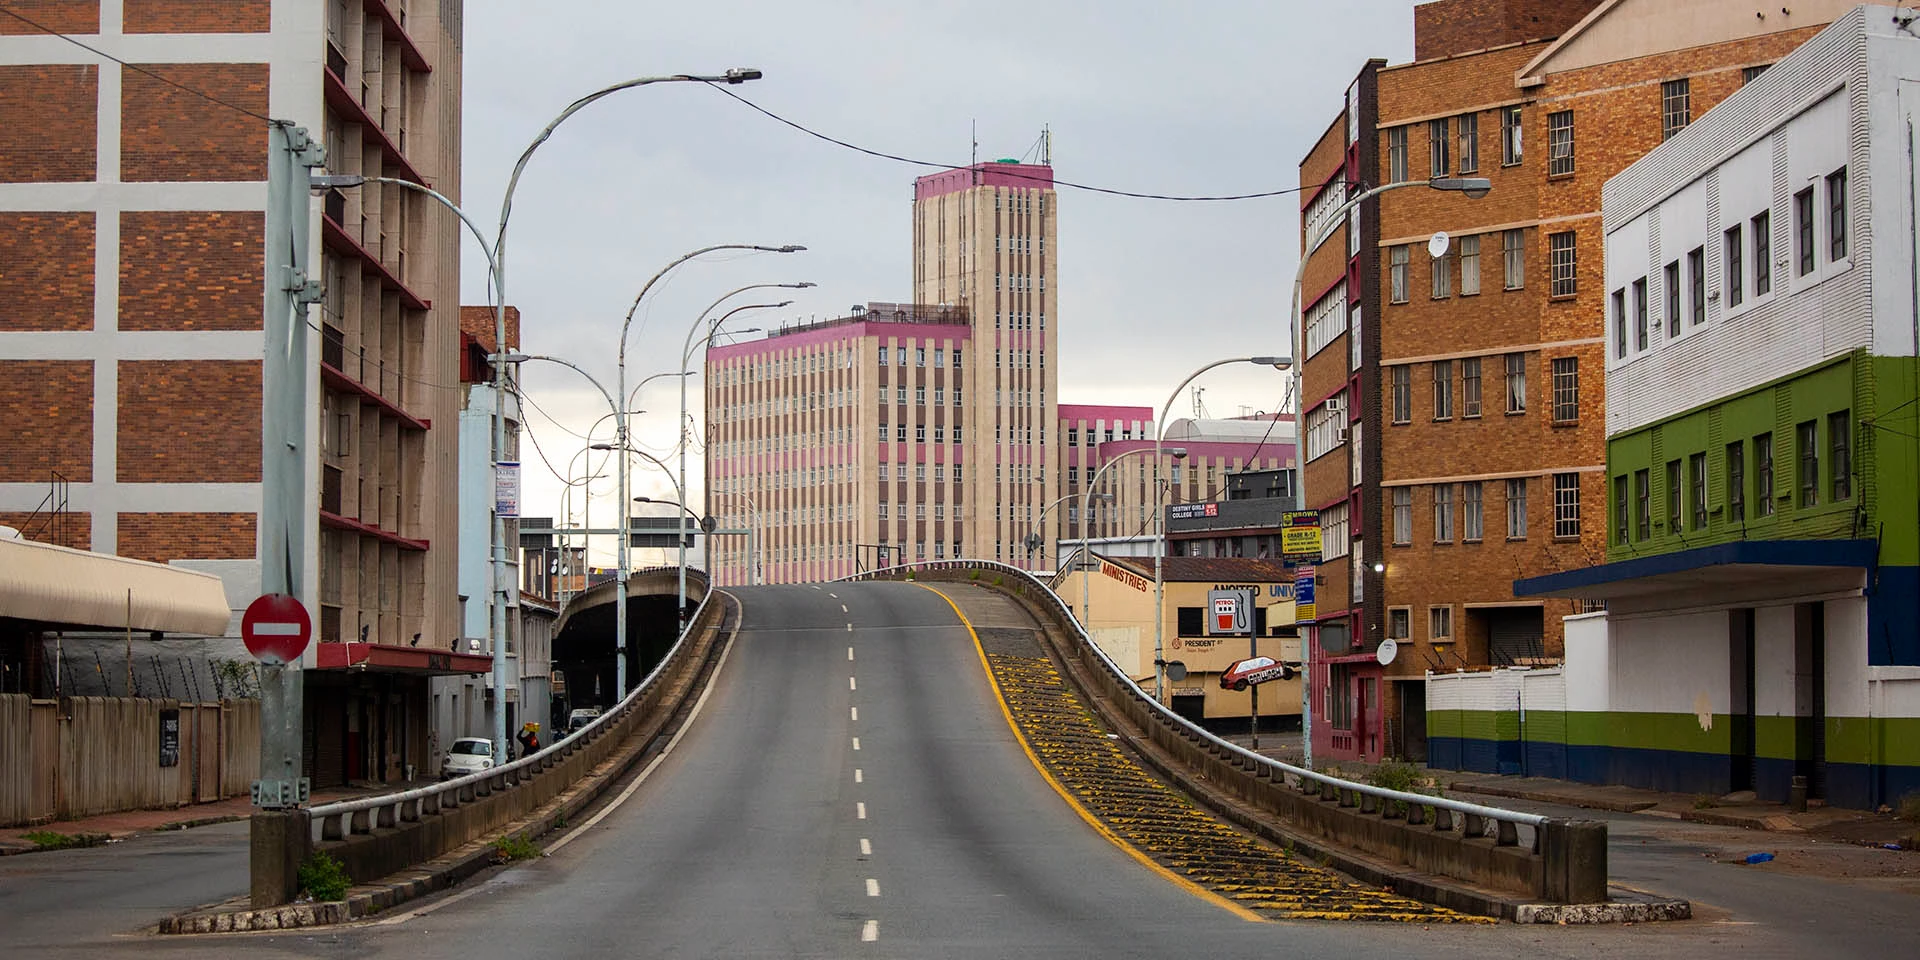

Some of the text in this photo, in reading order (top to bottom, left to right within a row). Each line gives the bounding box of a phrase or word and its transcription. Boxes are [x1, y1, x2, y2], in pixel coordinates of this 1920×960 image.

[1102, 562, 1147, 592] MINISTRIES
[1247, 666, 1283, 685] CAR WASH
